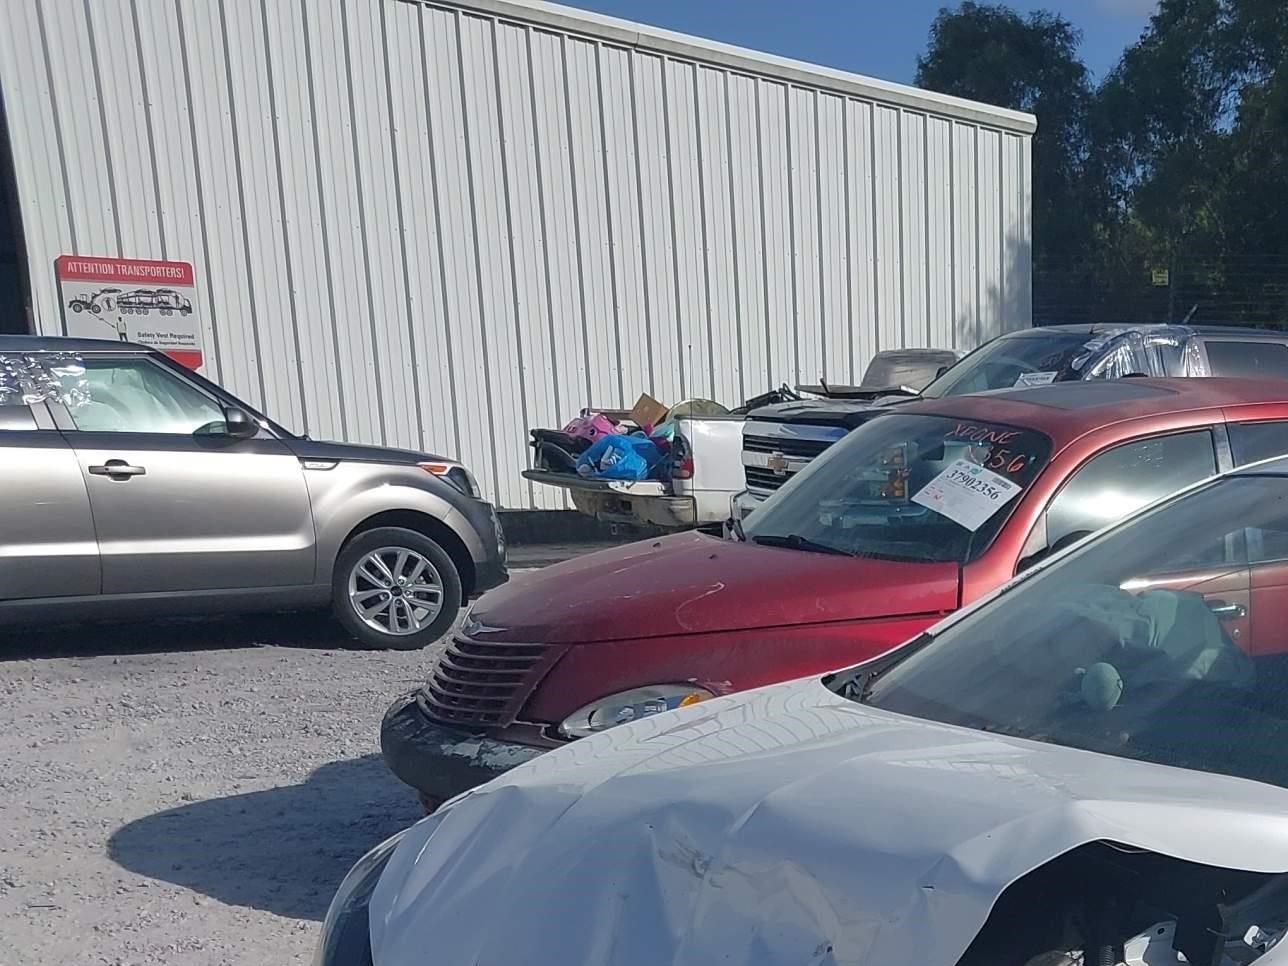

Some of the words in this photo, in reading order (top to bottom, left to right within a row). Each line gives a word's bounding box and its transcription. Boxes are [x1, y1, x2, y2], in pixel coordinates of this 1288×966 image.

[67, 261, 115, 275] ATTENTION
[115, 264, 185, 279] TRANSPORTERS!
[946, 469, 1000, 501] 37902356
